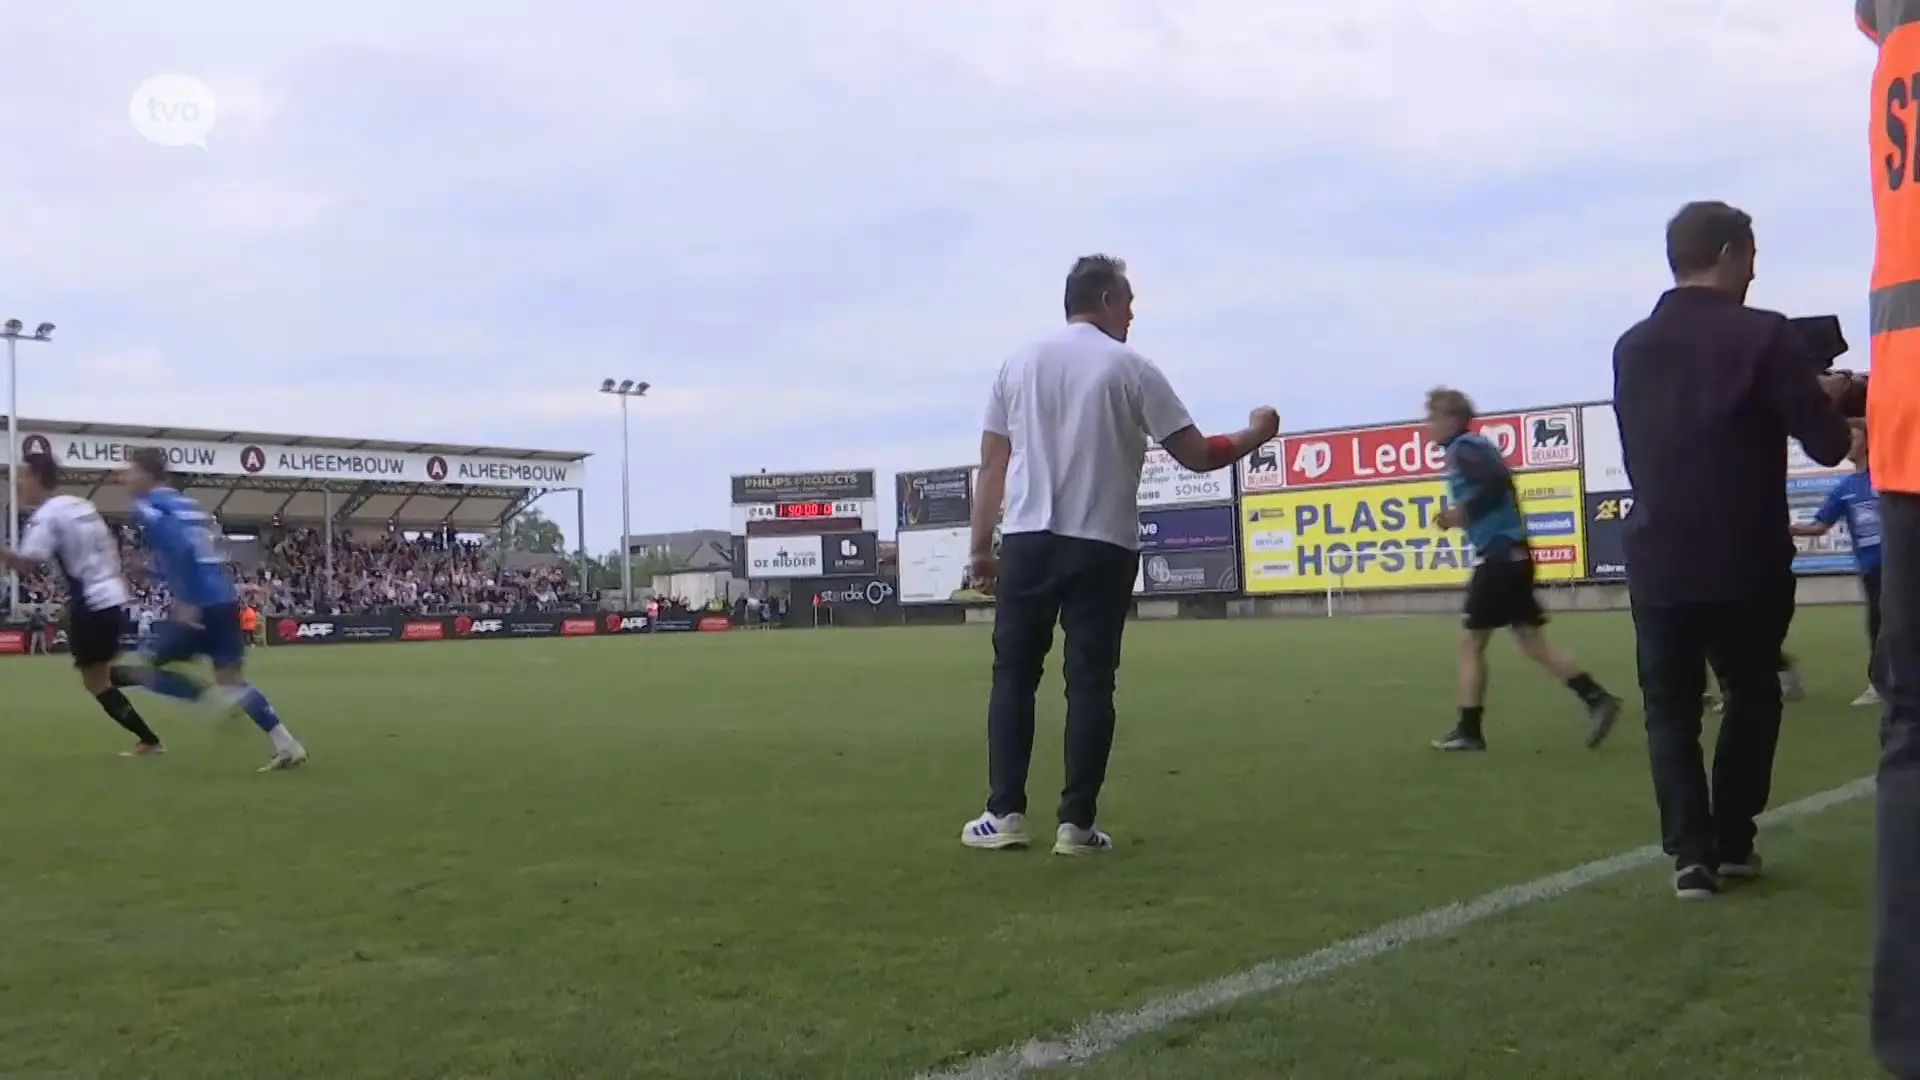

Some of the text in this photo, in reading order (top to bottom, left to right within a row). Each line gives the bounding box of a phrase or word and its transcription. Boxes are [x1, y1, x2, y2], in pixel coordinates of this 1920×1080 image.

[1353, 431, 1446, 476] Lede
[278, 453, 404, 475] ALHEEMBOUW
[458, 462, 567, 482] ALHEEMBOUW
[744, 475, 793, 489] PHILIPS
[795, 472, 859, 487] PROJECTS
[1175, 481, 1221, 496] SONOS
